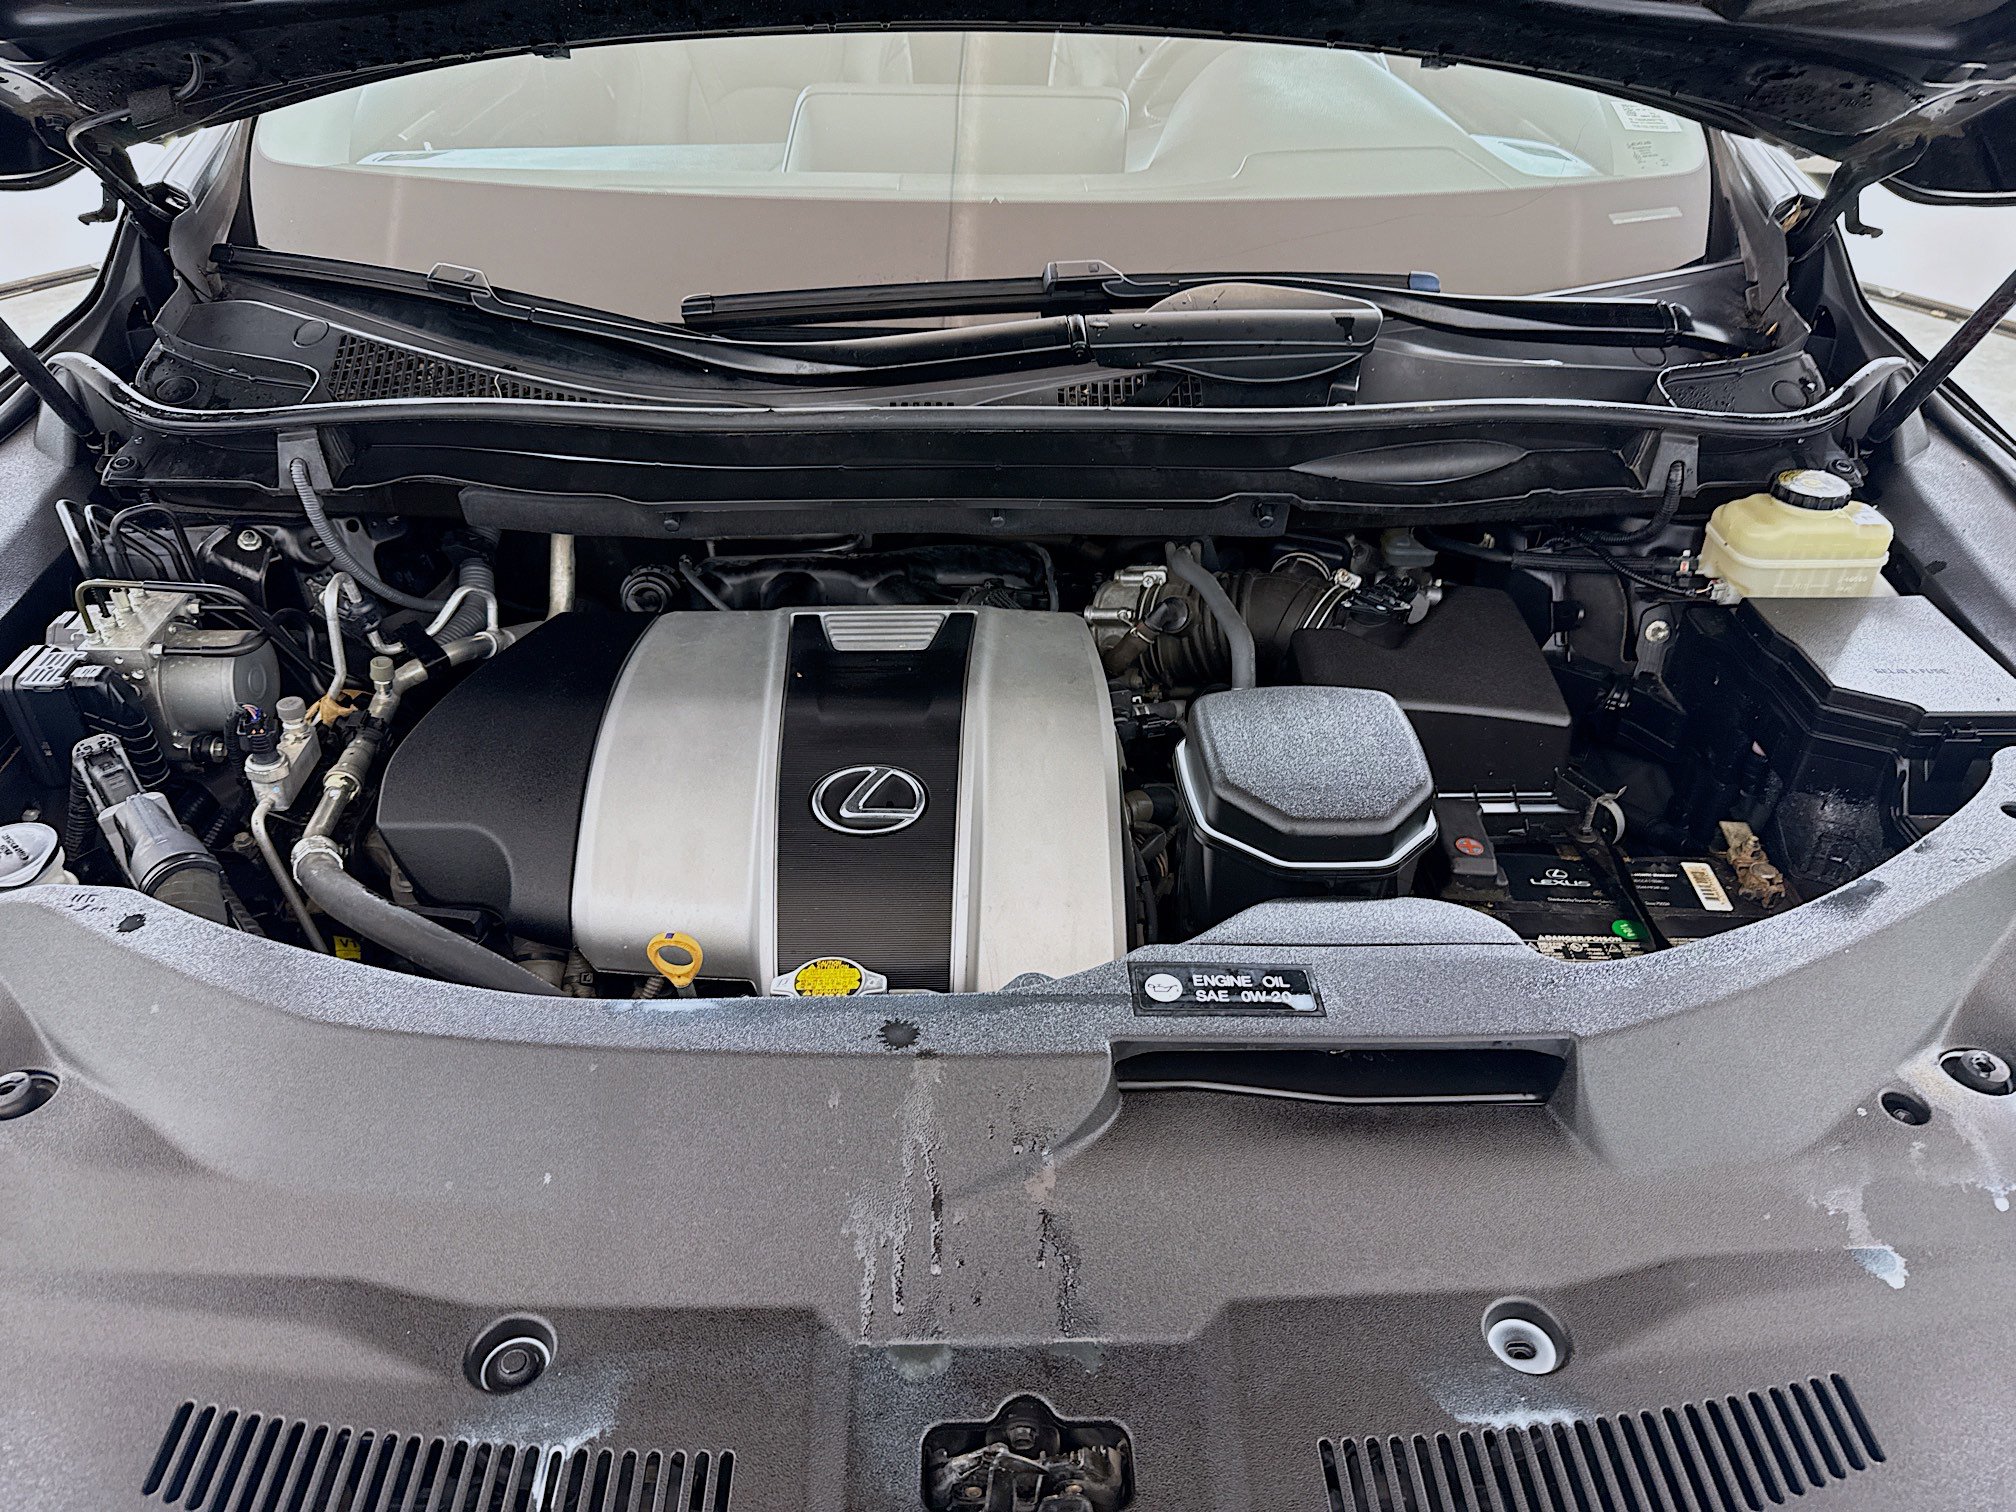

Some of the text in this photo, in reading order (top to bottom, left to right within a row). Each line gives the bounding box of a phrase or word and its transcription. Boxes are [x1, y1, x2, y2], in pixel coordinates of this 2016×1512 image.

[1529, 878, 1592, 887] LEXUS
[1192, 974, 1291, 989] ENGINE OIL
[1195, 990, 1292, 1004] SAE 0W-20
